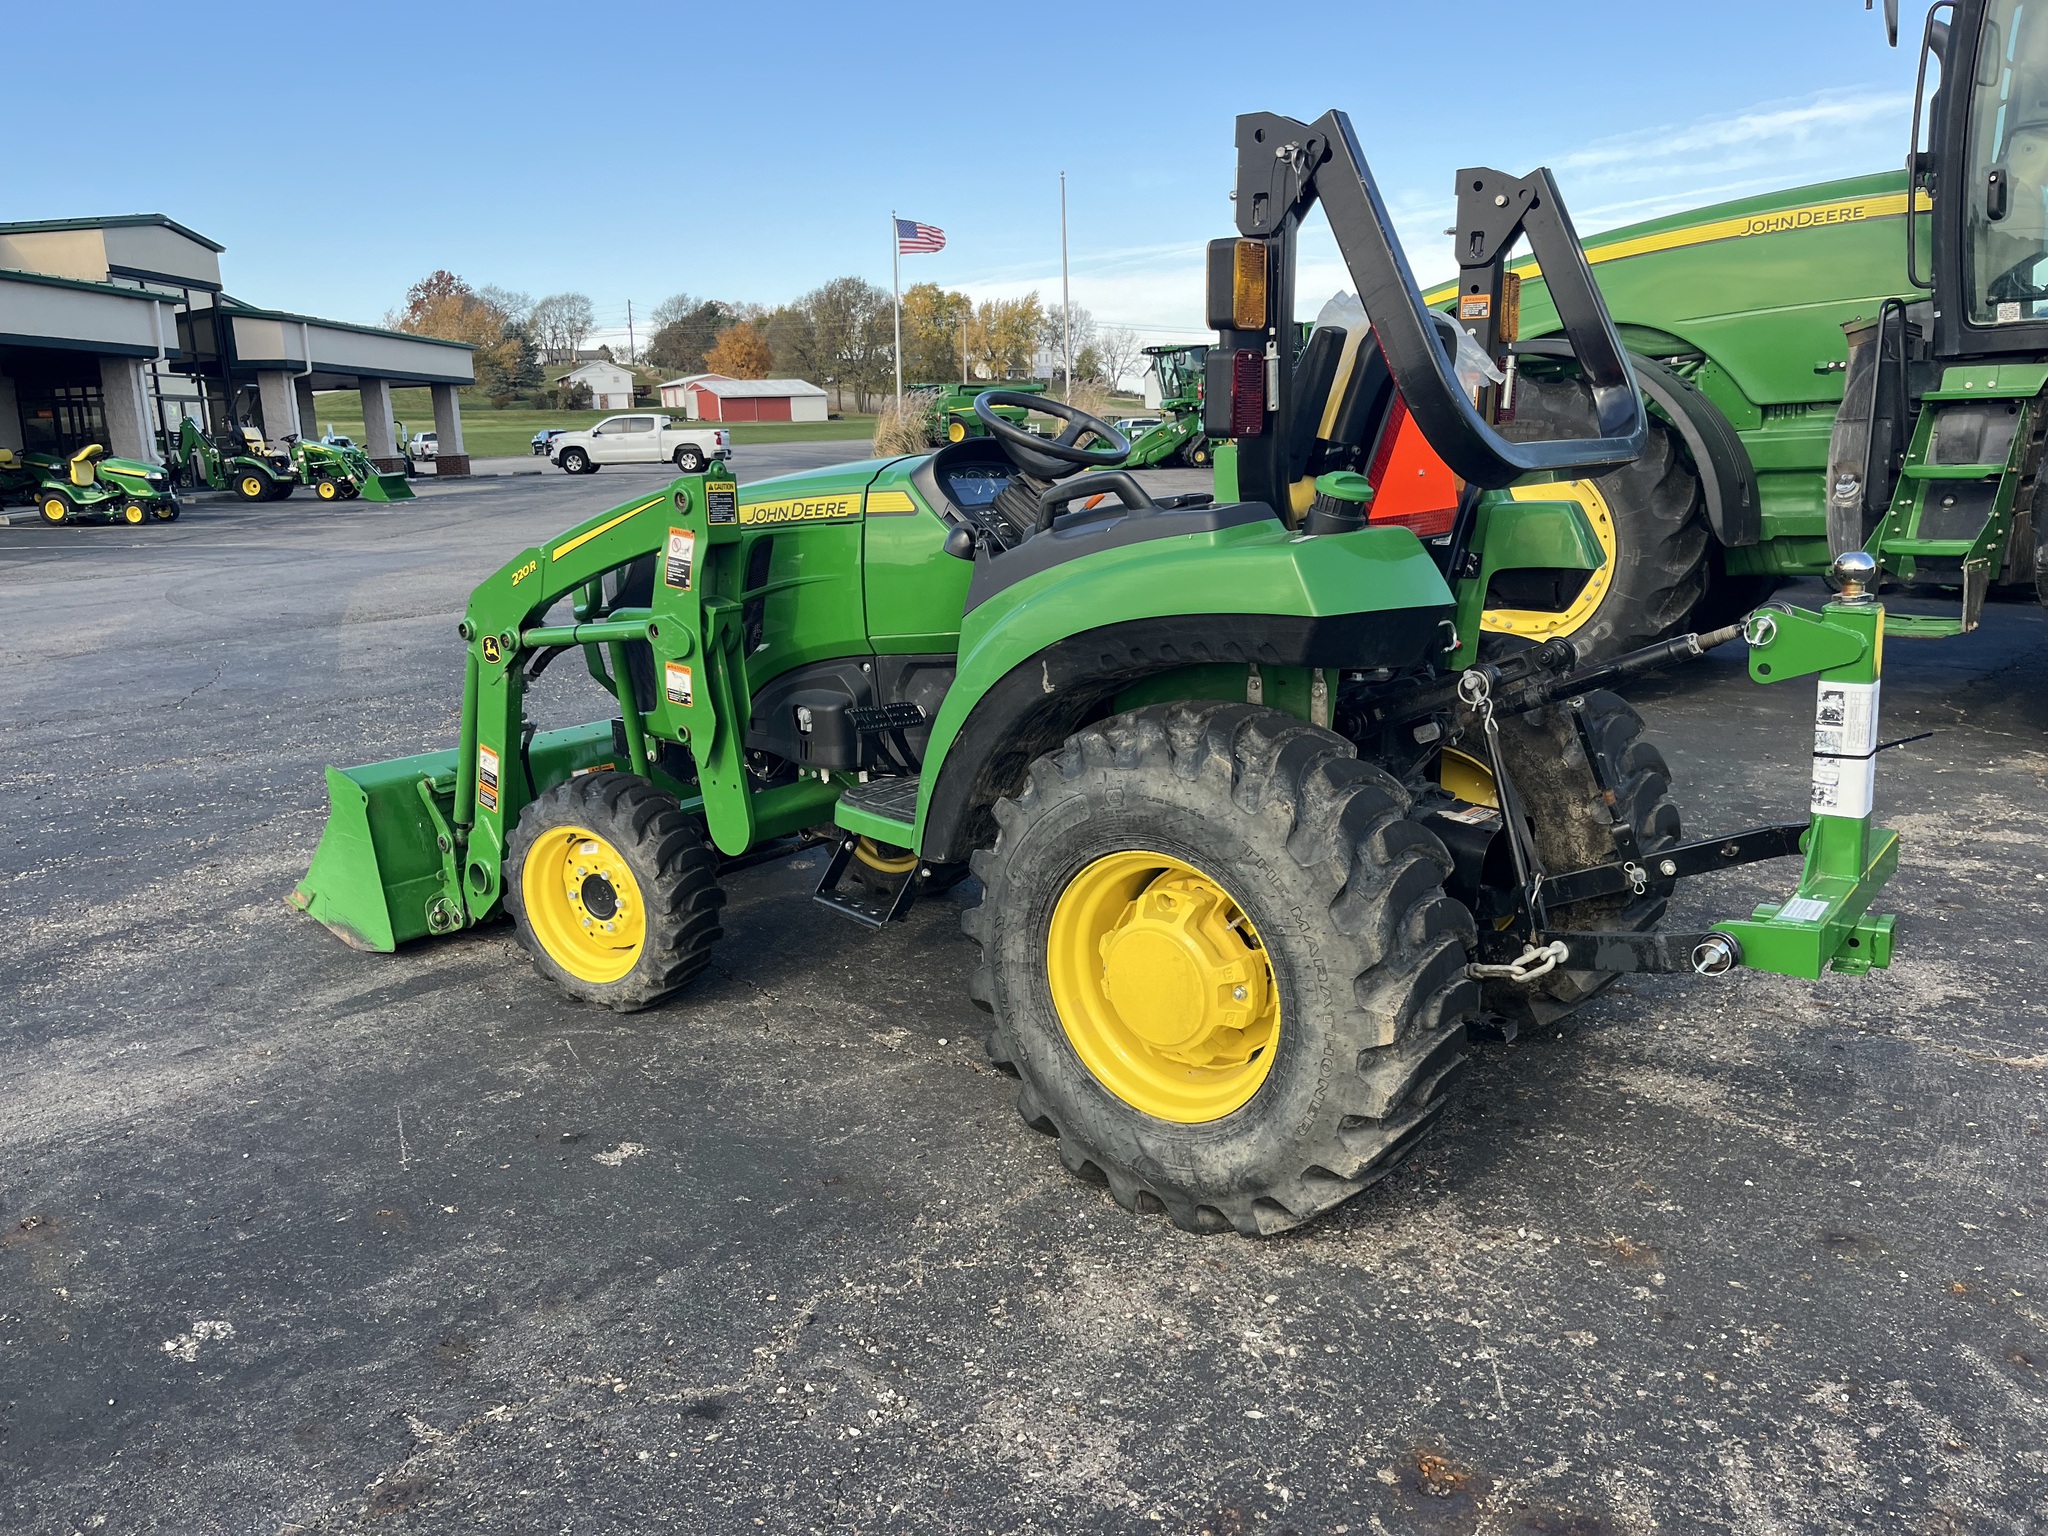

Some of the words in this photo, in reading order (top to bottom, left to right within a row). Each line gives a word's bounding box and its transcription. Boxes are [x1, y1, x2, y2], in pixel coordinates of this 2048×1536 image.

[1741, 216, 1794, 235] JOHN
[1797, 206, 1865, 226] DEERE
[714, 483, 734, 491] CAUTION
[747, 506, 790, 523] JOHN
[791, 501, 848, 519] DEERE
[1241, 840, 1292, 898] THE
[1291, 907, 1336, 1137] MARATHONER
